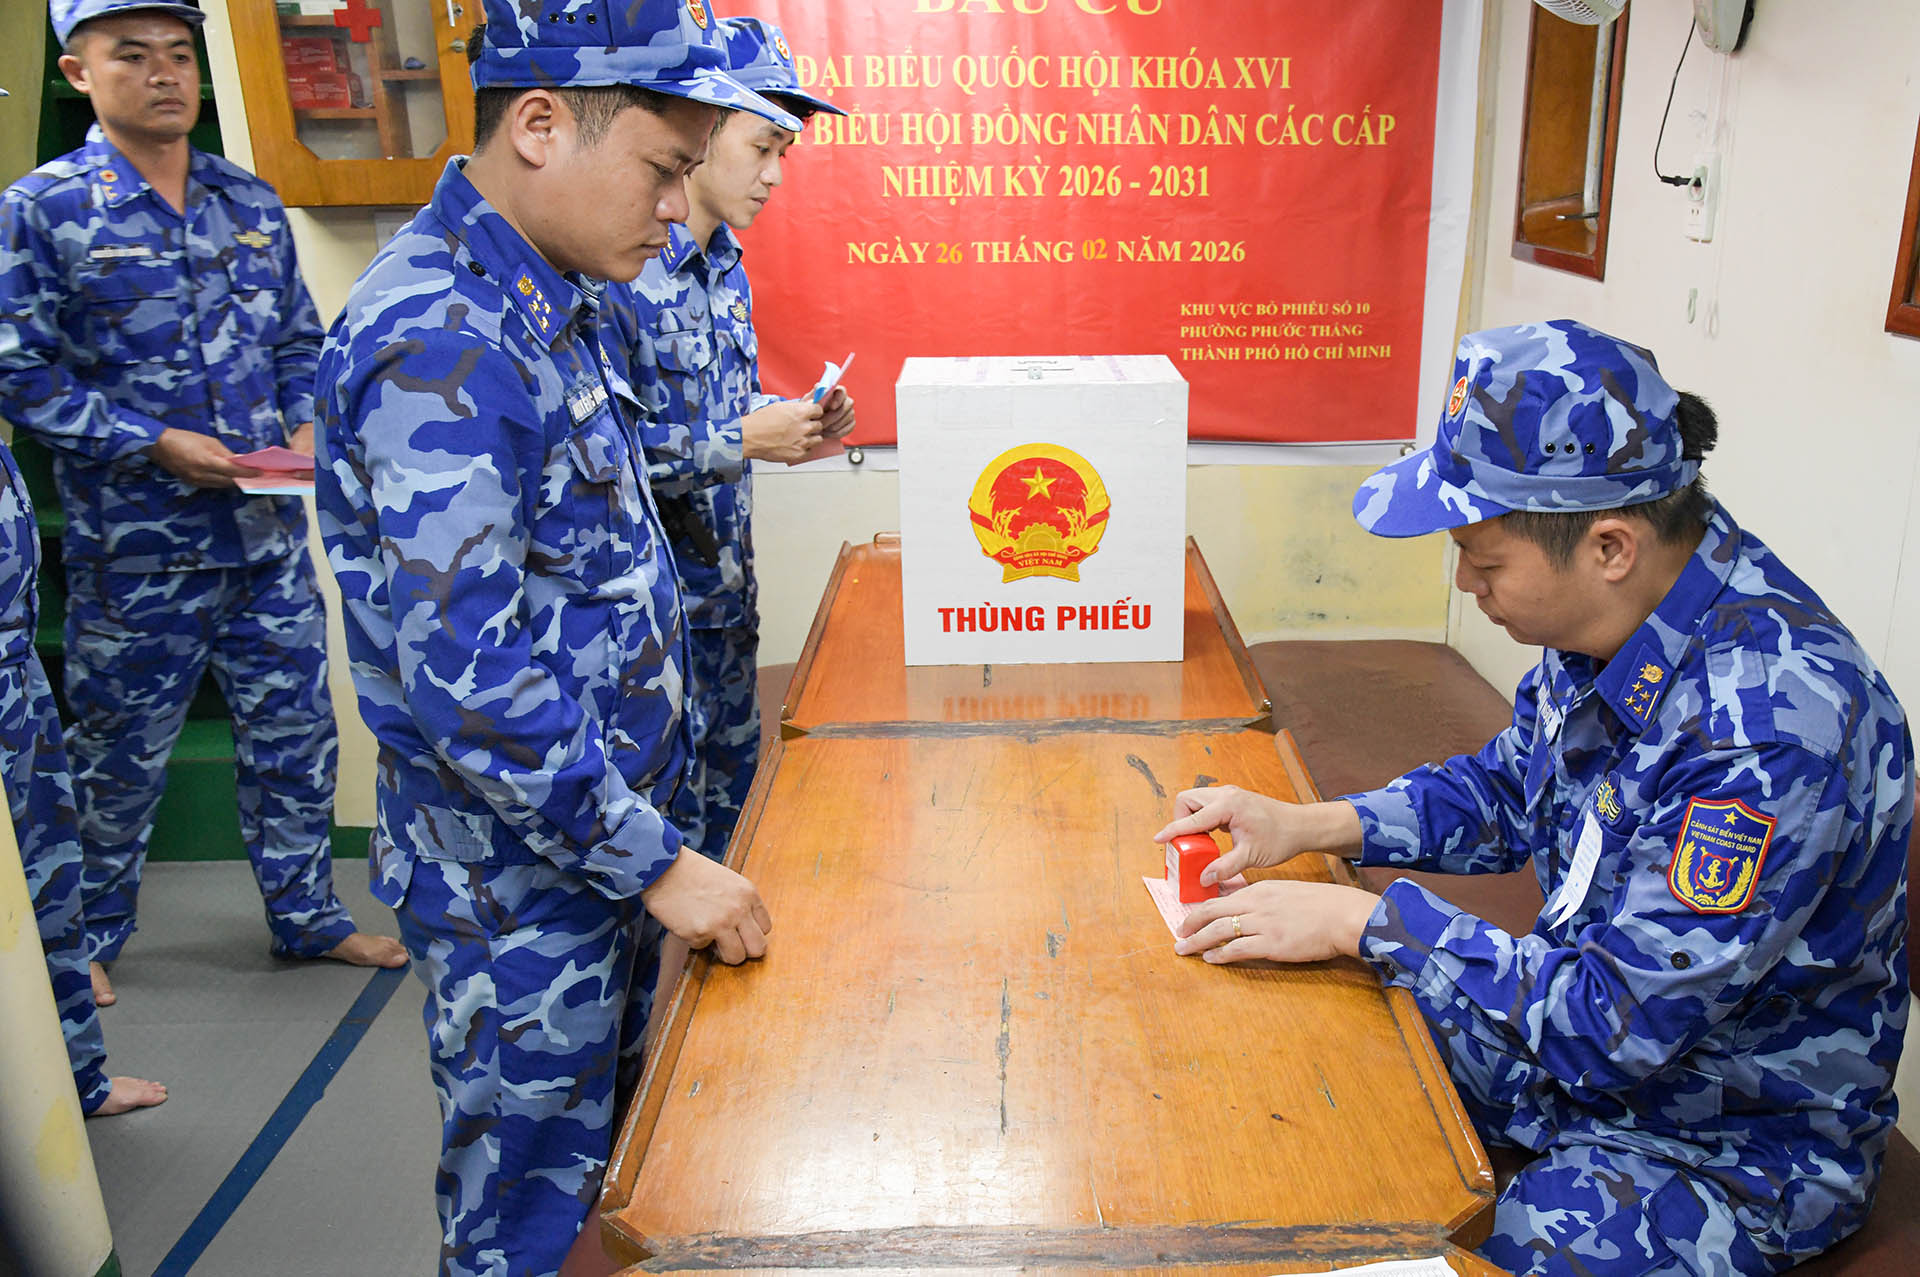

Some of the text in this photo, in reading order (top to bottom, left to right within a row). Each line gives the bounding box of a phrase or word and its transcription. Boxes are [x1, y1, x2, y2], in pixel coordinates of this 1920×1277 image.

[795, 44, 1292, 97] ĐẠI BIỂU QUỐC HỘI KHÓA XVI
[812, 103, 1396, 154] BIỂU HỘI ĐỒNG NHÂN DÂN CÁC CẤP
[881, 160, 994, 206] NHIỆM
[1002, 155, 1051, 197] KỲ
[1058, 164, 1123, 197] 2026
[1148, 164, 1210, 197] 2031
[847, 235, 1247, 264] NGÀY 26 THÁNG 02 NĂM 2026
[1180, 303, 1215, 316] KHU
[1218, 302, 1254, 319] VỰC
[1356, 302, 1371, 315] 10
[1180, 322, 1248, 338] PHƯỜNG
[1251, 322, 1307, 338] PHƯỚC
[1180, 342, 1393, 361] THÀNH PHỐ HỒ CHÍ MINH
[1042, 557, 1063, 567] NAM
[937, 596, 1152, 633] THÙNG PHIẾU
[1716, 838, 1736, 848] COAST
